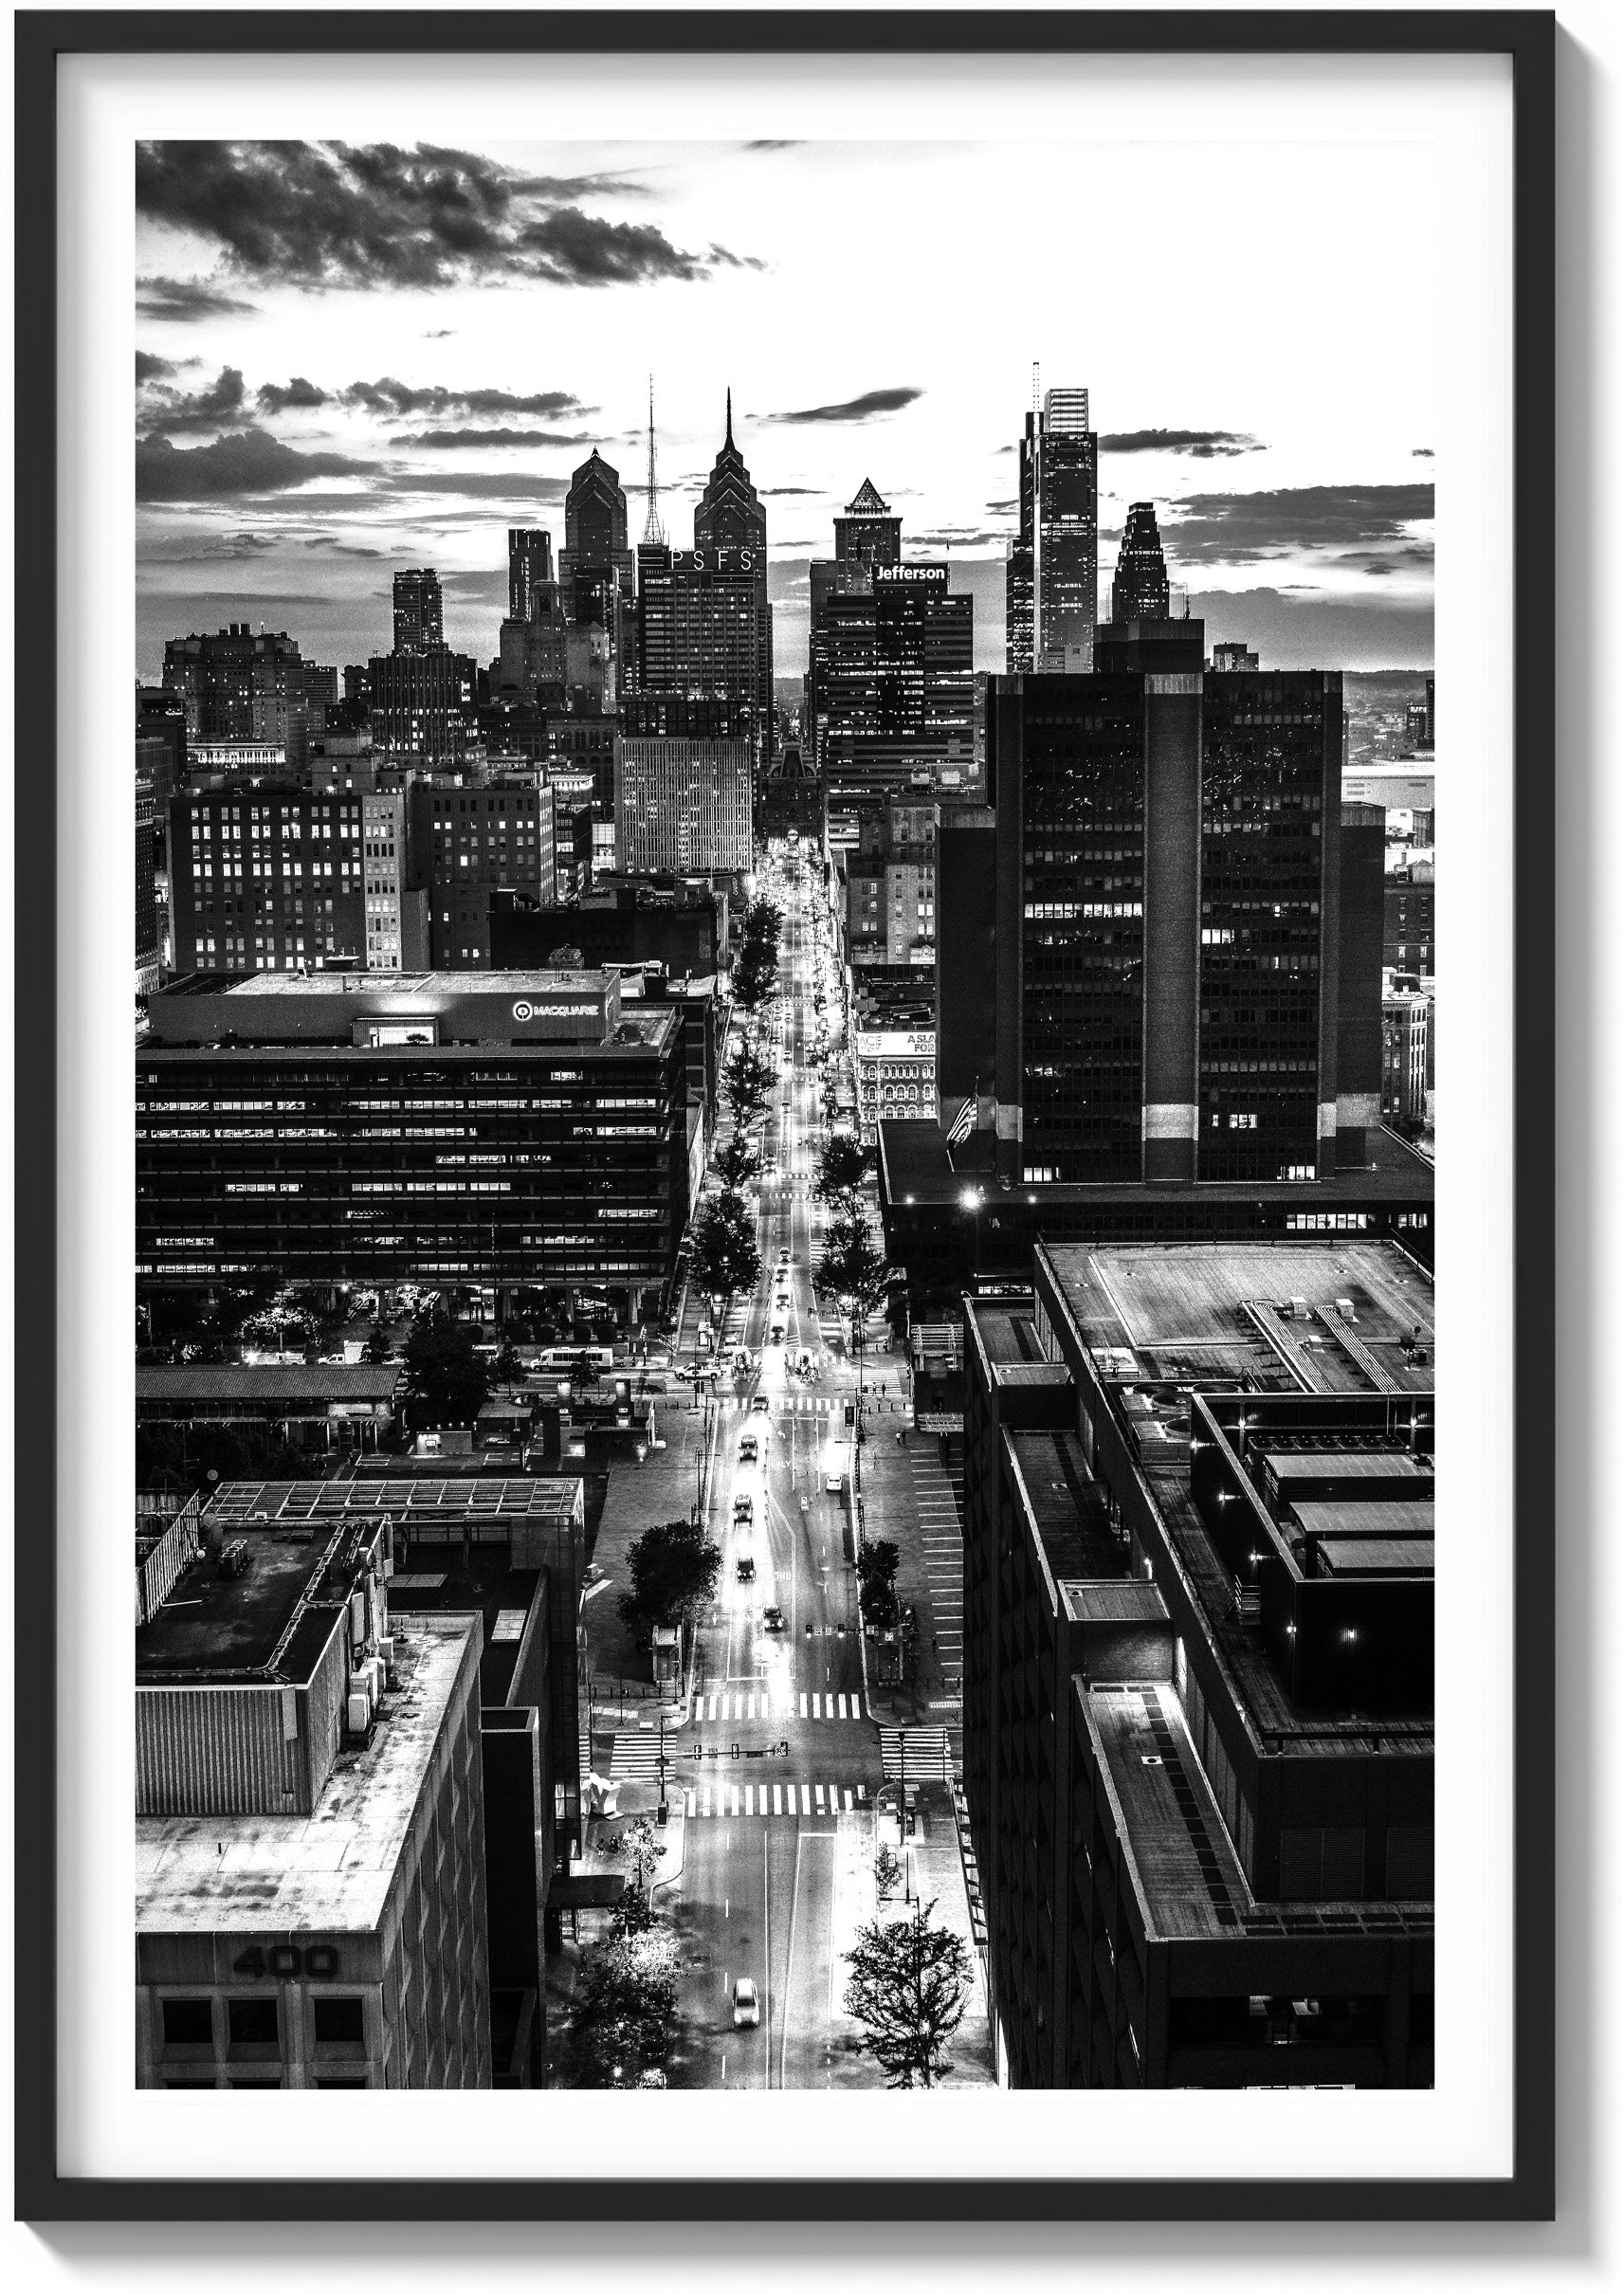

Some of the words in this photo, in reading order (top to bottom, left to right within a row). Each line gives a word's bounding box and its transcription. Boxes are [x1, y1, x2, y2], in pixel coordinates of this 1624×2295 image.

[670, 551, 752, 570] PSFS
[876, 566, 946, 580] Jefferson
[533, 1005, 599, 1016] MACQUARIE
[233, 1945, 338, 1977] 400
